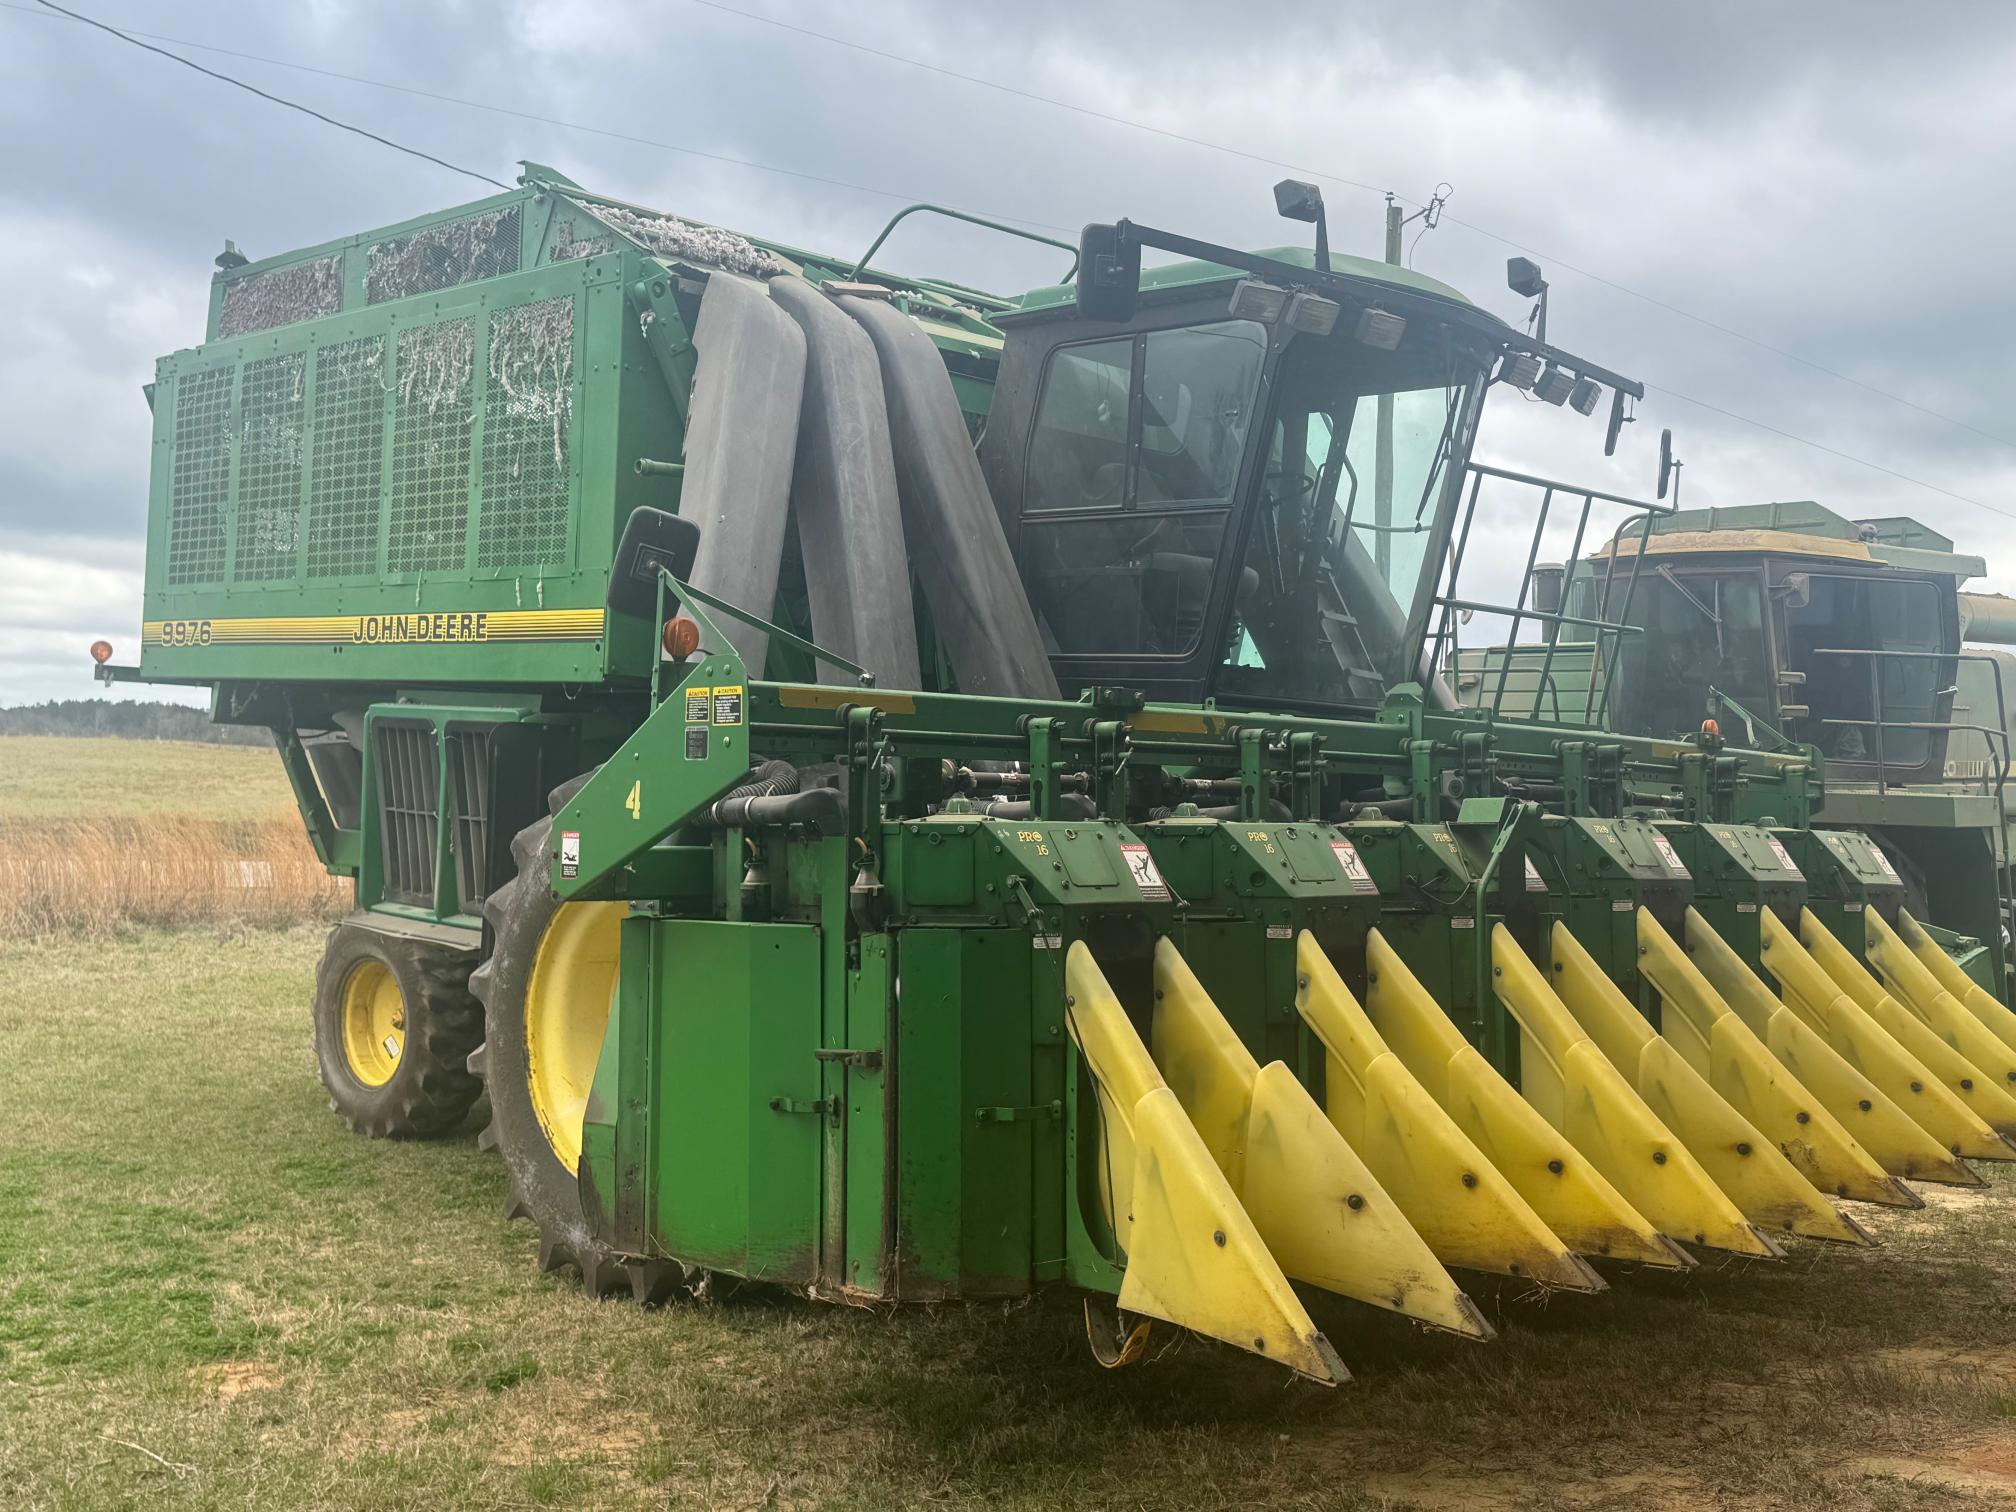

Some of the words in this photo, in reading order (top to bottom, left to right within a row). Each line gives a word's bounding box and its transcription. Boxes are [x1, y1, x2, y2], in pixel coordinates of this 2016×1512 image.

[161, 620, 212, 646] 9976
[353, 615, 409, 643] JOHN
[416, 613, 488, 642] DEERE
[625, 779, 641, 820] 4
[1017, 831, 1043, 842] PRO
[1247, 831, 1269, 842] PRO
[1036, 844, 1049, 856] 16
[1263, 843, 1275, 854] 16
